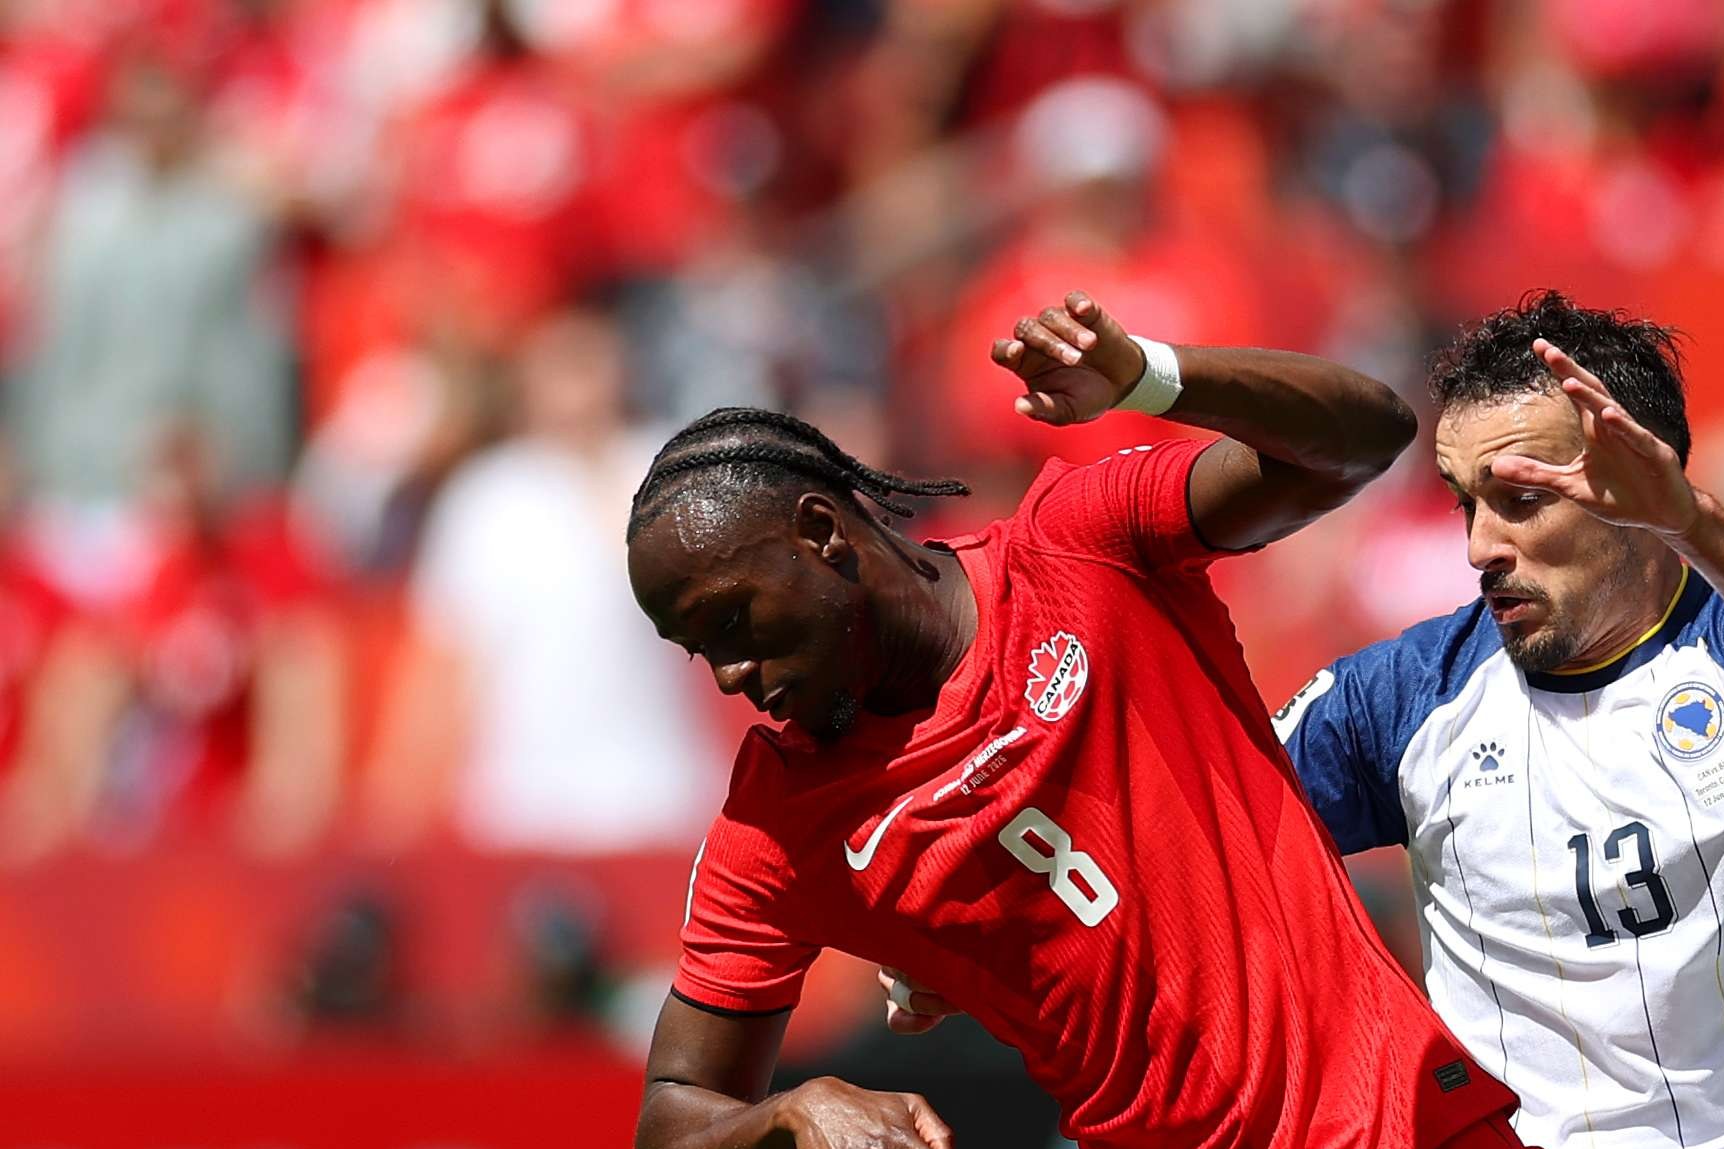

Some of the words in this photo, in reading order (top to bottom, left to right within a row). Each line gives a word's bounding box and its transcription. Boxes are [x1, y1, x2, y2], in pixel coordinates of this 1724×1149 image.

[1037, 643, 1078, 714] CANADA
[960, 783, 971, 796] 12
[969, 769, 990, 788] JUNE
[988, 754, 1007, 773] 2026
[1464, 773, 1515, 789] KELME
[1703, 798, 1712, 807] 12
[998, 807, 1119, 928] 8
[1567, 820, 1679, 951] 13
